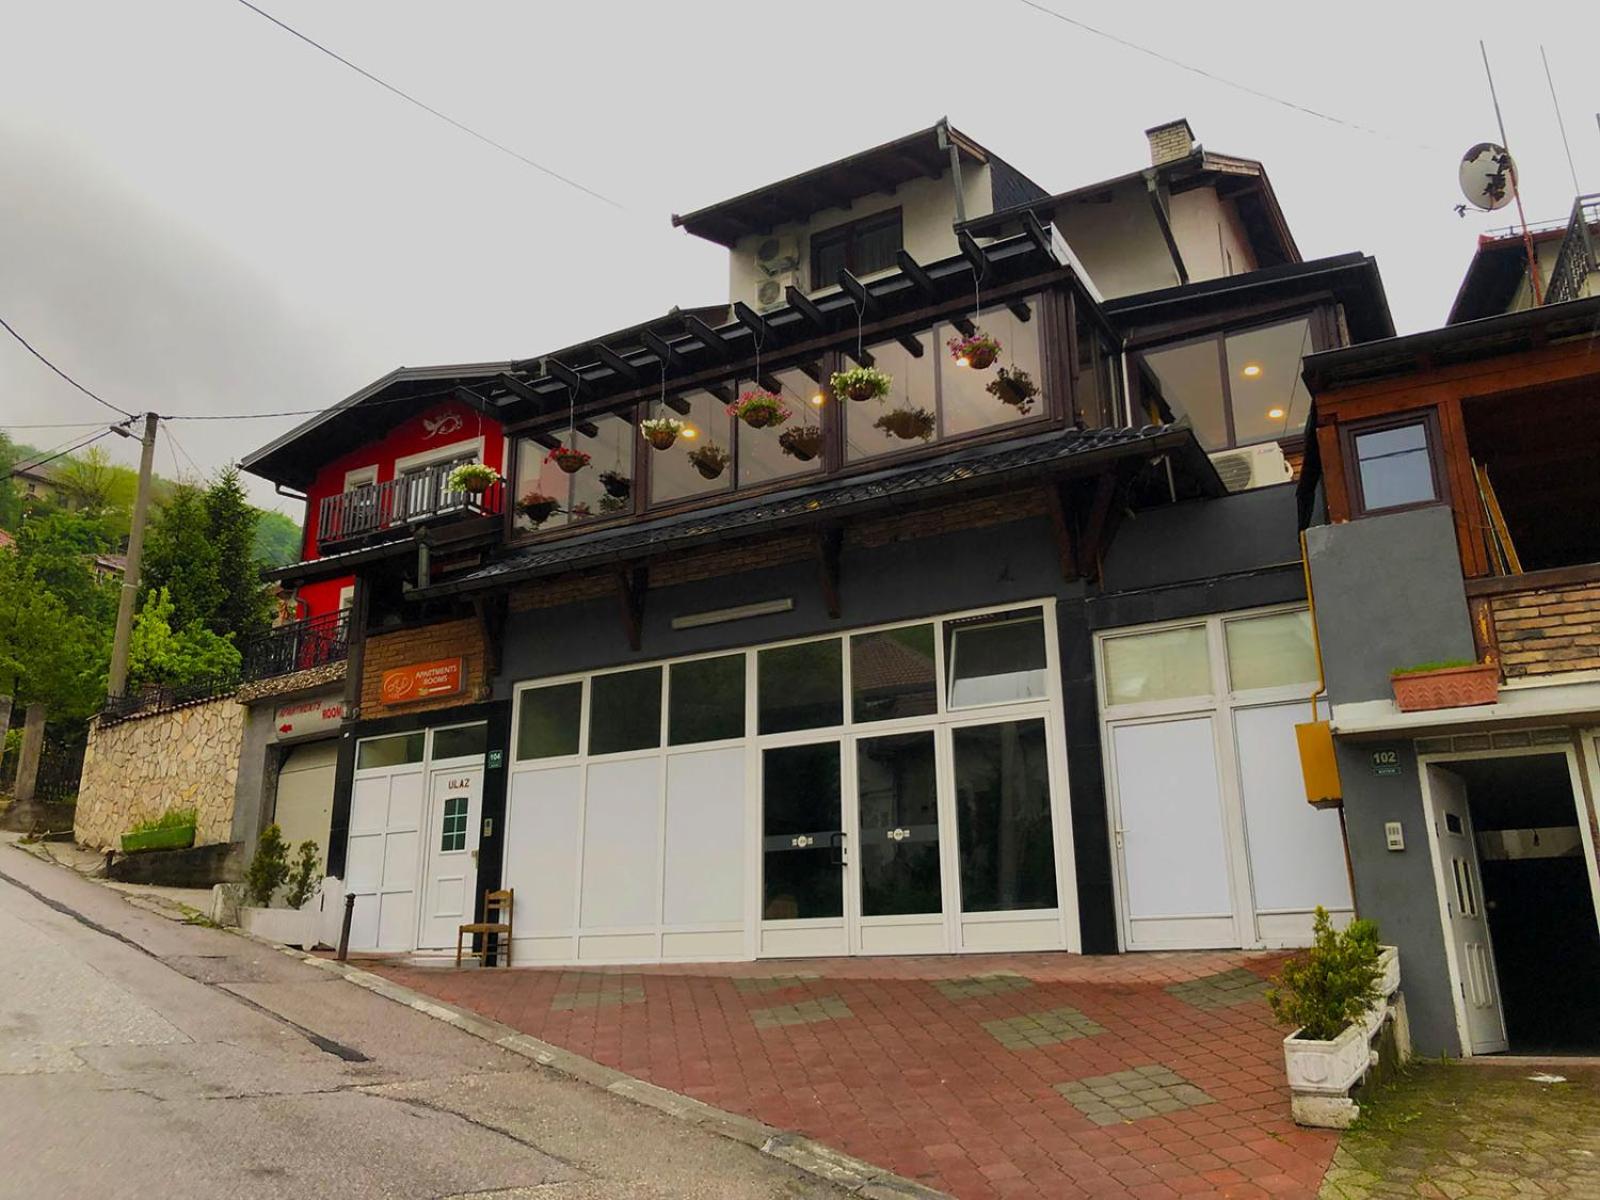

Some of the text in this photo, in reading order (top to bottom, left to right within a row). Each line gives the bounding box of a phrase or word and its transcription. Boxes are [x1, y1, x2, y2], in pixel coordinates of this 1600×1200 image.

[415, 665, 457, 680] APARTMENTS
[423, 675, 448, 685] ROOMS
[1373, 751, 1397, 764] 102
[448, 777, 471, 790] ULAZ
